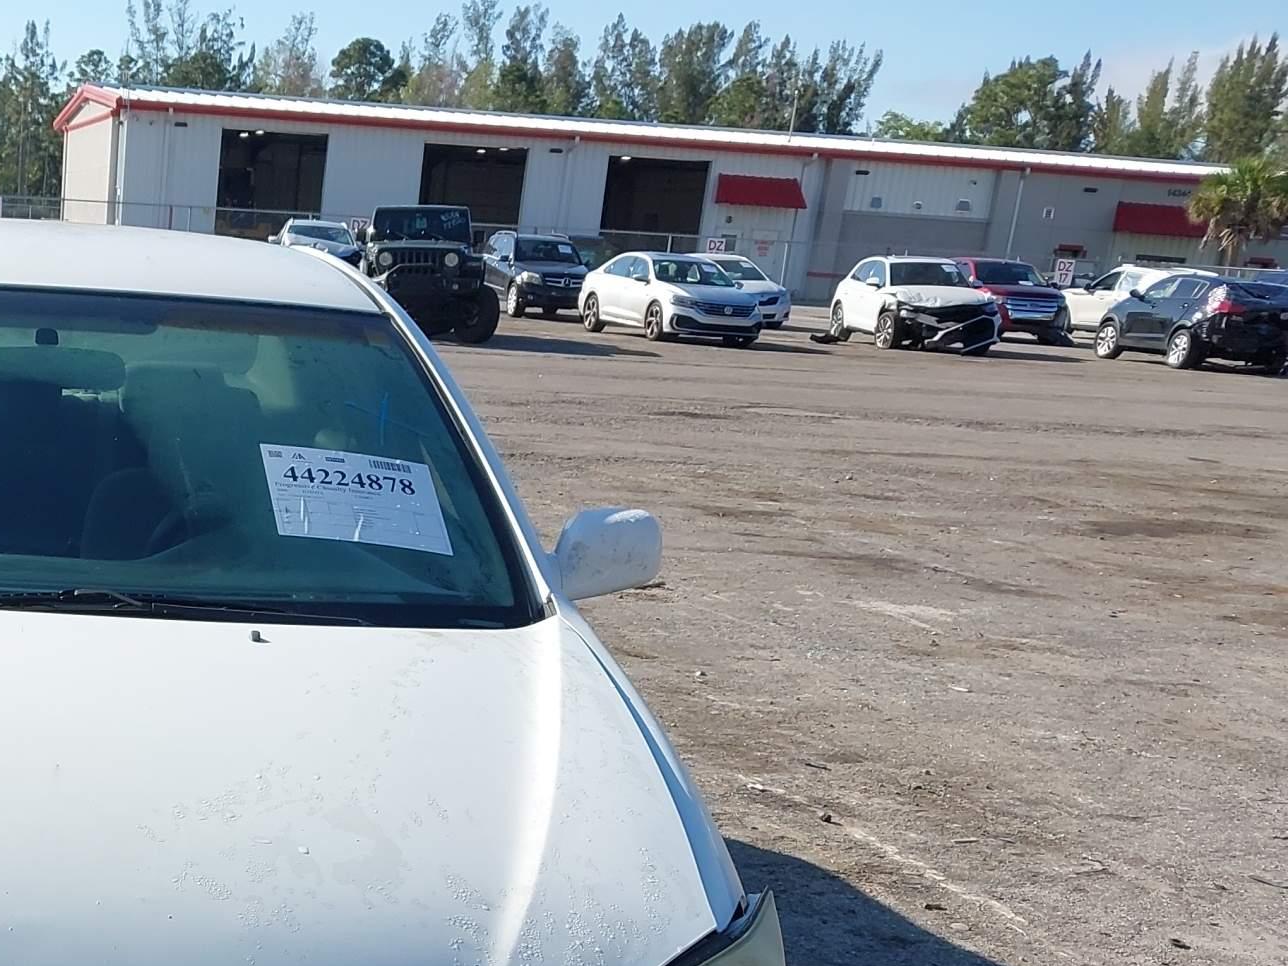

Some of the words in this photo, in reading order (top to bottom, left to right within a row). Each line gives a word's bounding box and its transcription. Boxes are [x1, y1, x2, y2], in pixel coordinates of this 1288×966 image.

[708, 240, 724, 252] DZ
[1058, 260, 1074, 273] DZ
[1059, 272, 1069, 284] 17
[283, 466, 417, 496] 44224878
